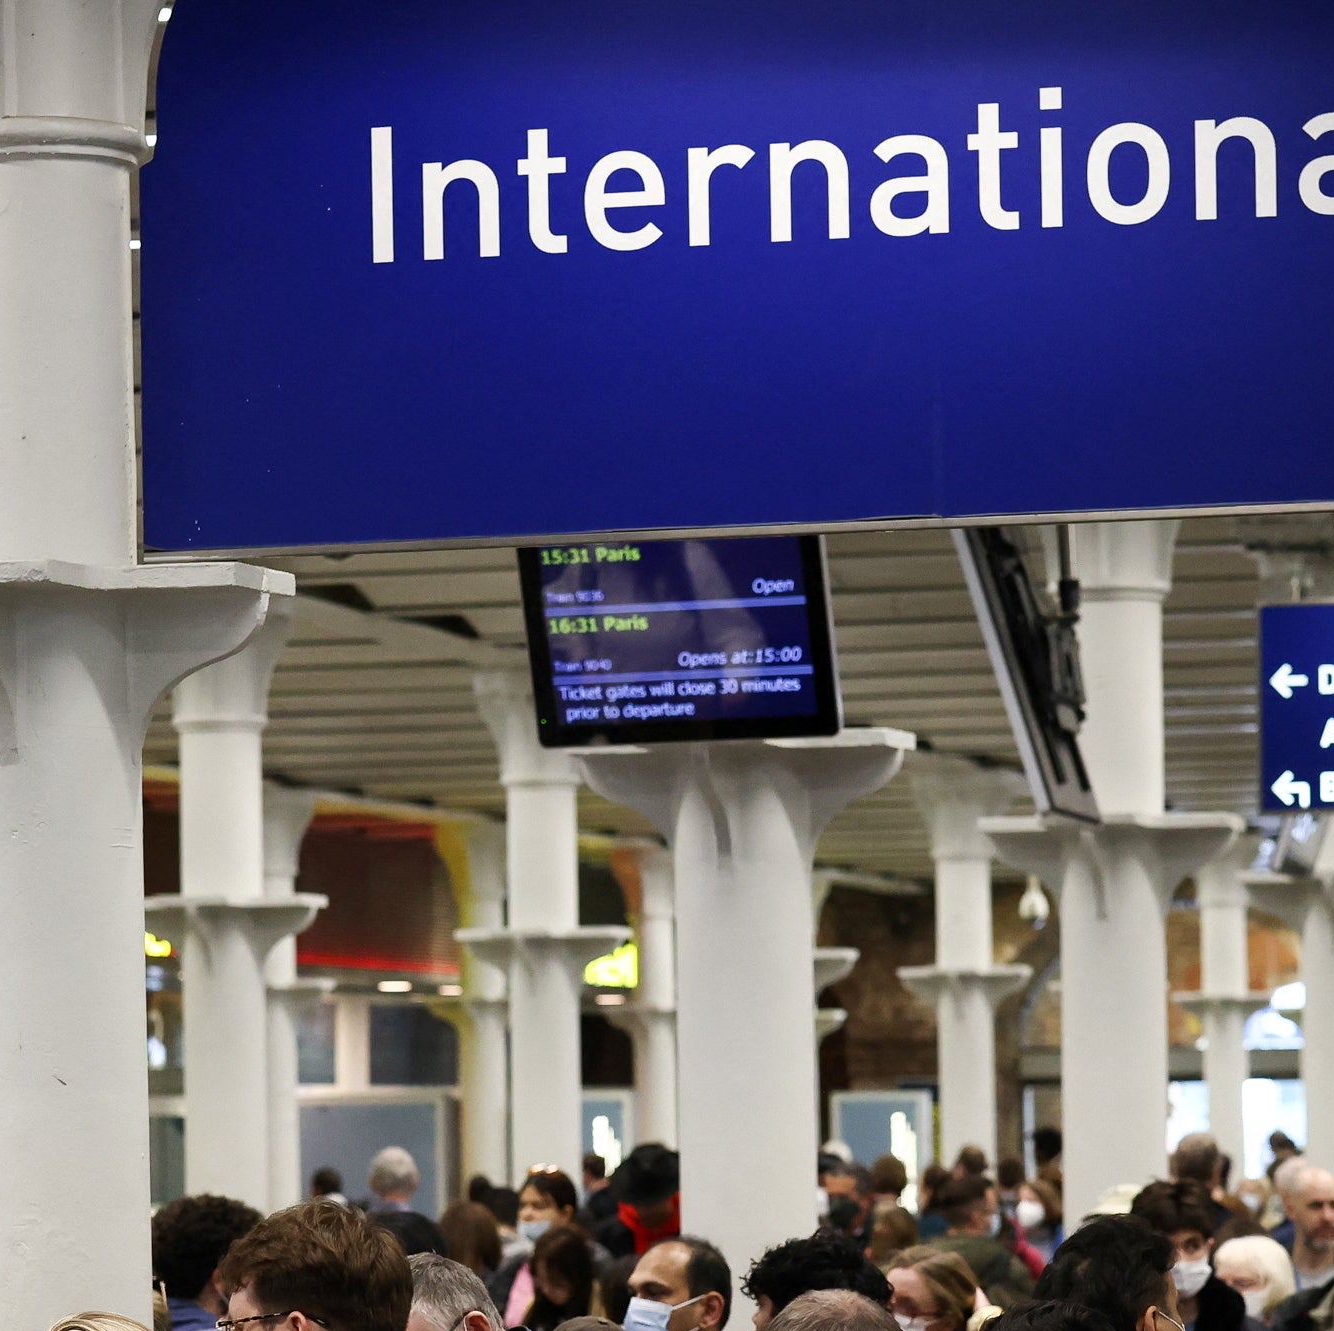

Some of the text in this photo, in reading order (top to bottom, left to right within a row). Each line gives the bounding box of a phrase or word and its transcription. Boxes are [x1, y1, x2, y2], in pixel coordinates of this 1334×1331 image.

[541, 545, 641, 566] 15:31 Paris
[752, 577, 795, 596] Open
[549, 614, 649, 635] 16:31 Paris
[677, 650, 727, 669] Opens
[559, 676, 801, 703] Ticket gates will close 30 minutes
[565, 702, 695, 723] prior to departure
